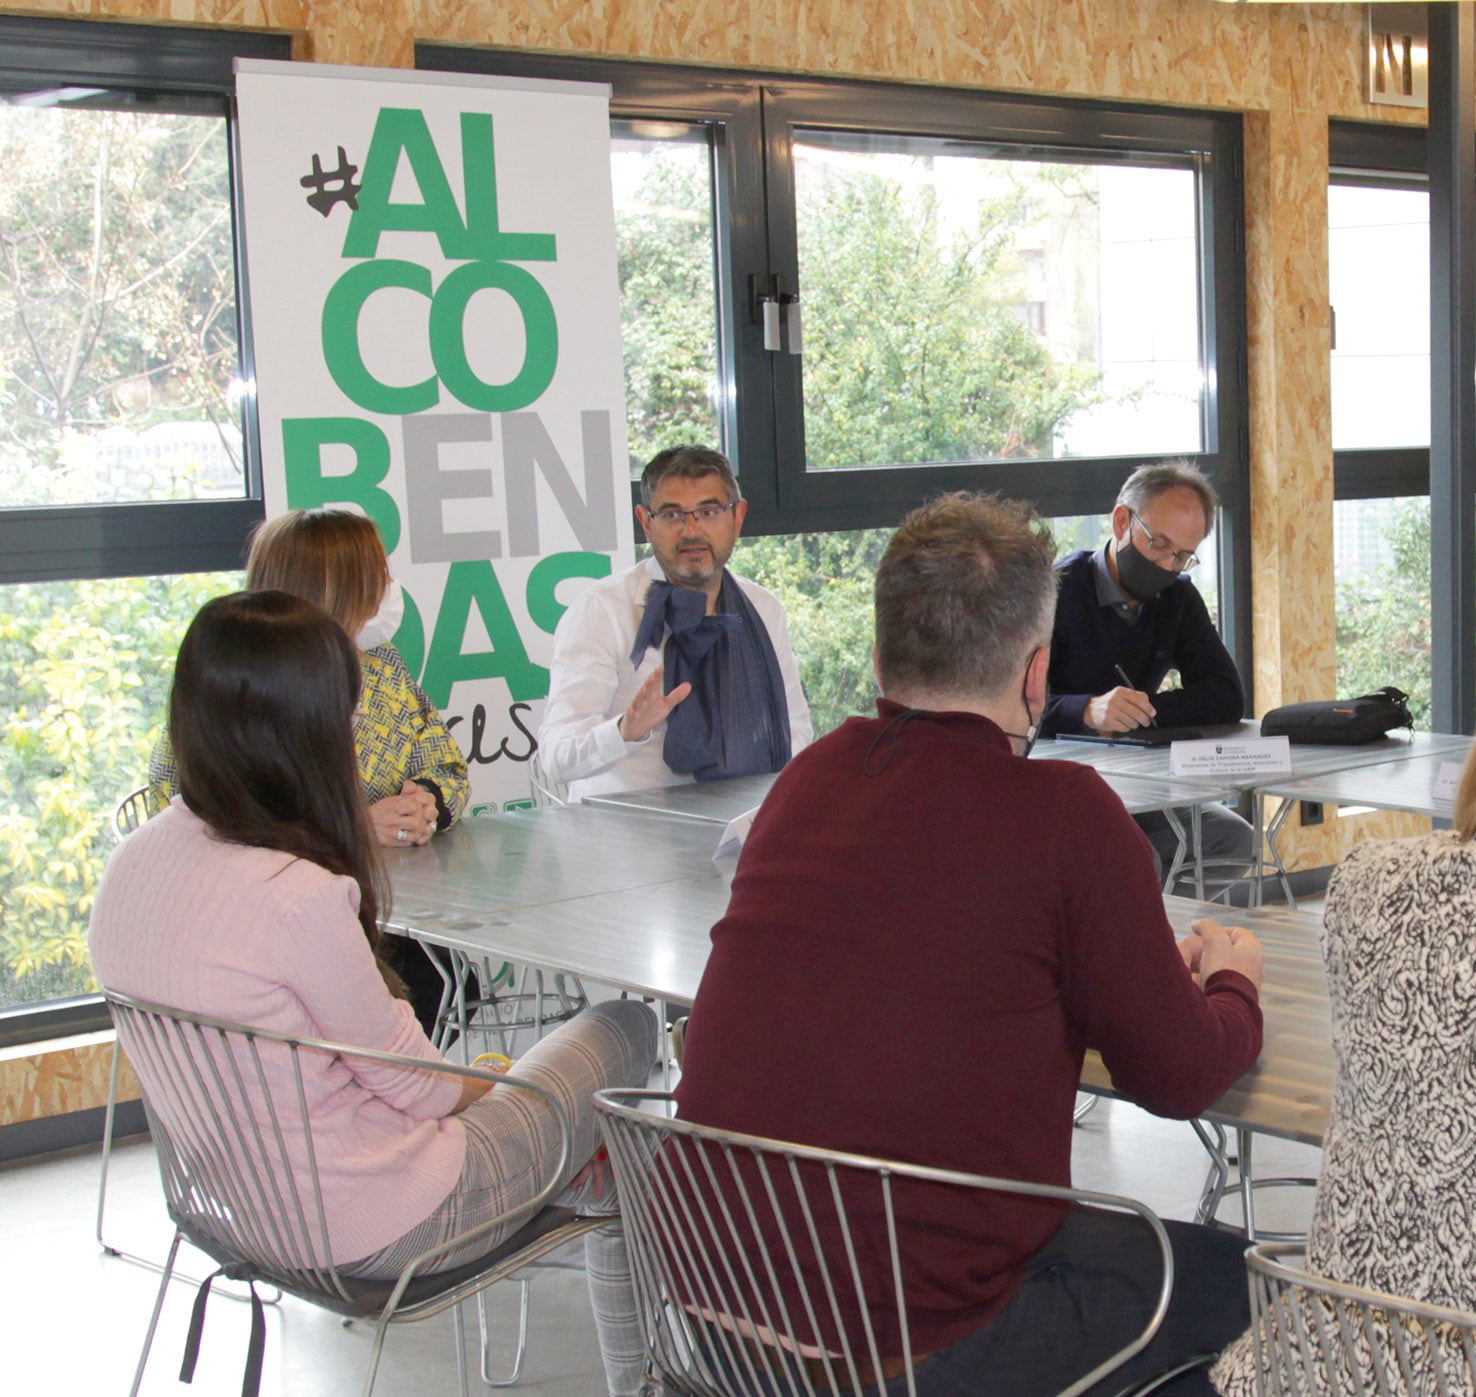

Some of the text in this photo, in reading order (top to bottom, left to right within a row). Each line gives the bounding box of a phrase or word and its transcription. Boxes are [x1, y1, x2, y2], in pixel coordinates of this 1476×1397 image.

[301, 107, 558, 262] #AL
[321, 259, 559, 415] CO
[281, 409, 618, 564] BEN
[391, 552, 612, 711] AS
